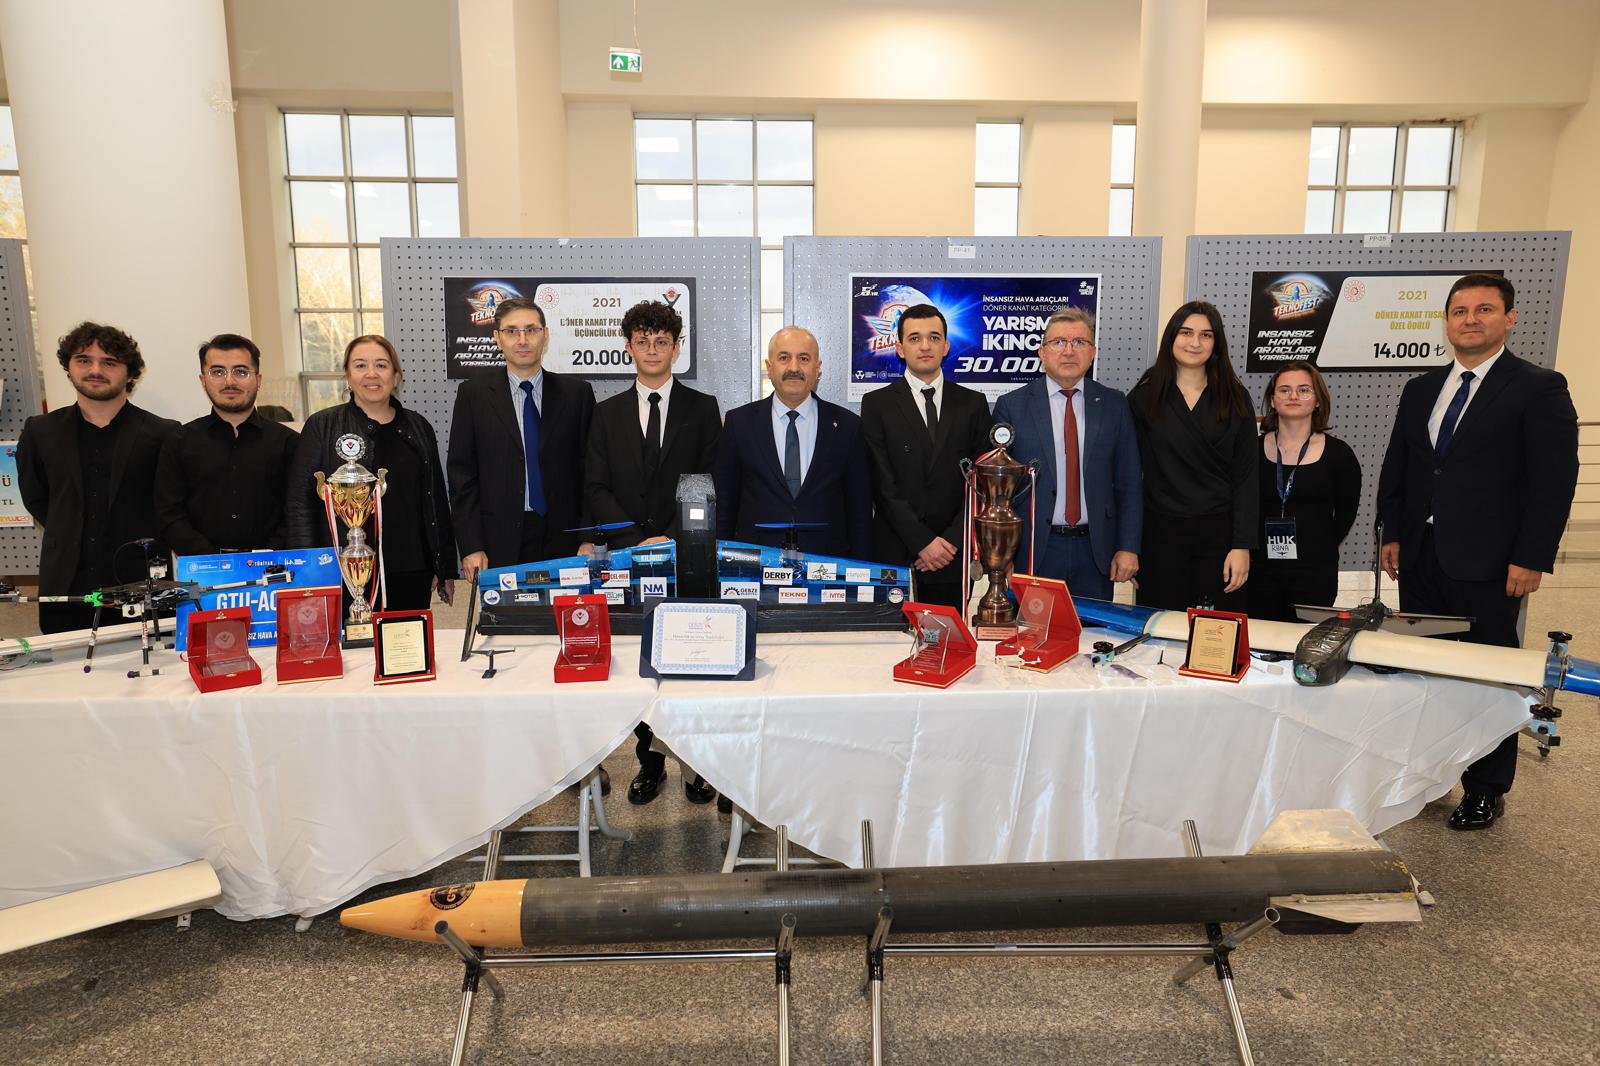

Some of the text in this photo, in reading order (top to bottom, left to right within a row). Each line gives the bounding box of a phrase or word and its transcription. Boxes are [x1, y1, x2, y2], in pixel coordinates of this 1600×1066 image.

[1036, 296, 1068, 304] ARAÇLARI
[1398, 290, 1427, 300] 2021
[592, 297, 621, 307] 2021
[983, 303, 1006, 311] DÖNER
[1274, 297, 1319, 318] TEKNOFEST
[470, 308, 496, 321] TEKNO
[1375, 311, 1398, 319] DÖNER
[1400, 311, 1422, 319] KANAT
[585, 318, 607, 326] KANAT
[609, 318, 622, 326] PER
[983, 316, 1051, 332] YARIŞM
[1390, 321, 1430, 330] ÖZEL ÖDÜLÜ
[574, 328, 616, 338] ÜÇÜNCÜLÜK
[871, 332, 899, 351] TEKN
[1373, 342, 1431, 359] 14.000
[1268, 535, 1295, 545] HUK
[763, 571, 792, 580] DERBY
[643, 583, 664, 593] NM
[257, 631, 273, 640] HAVA
